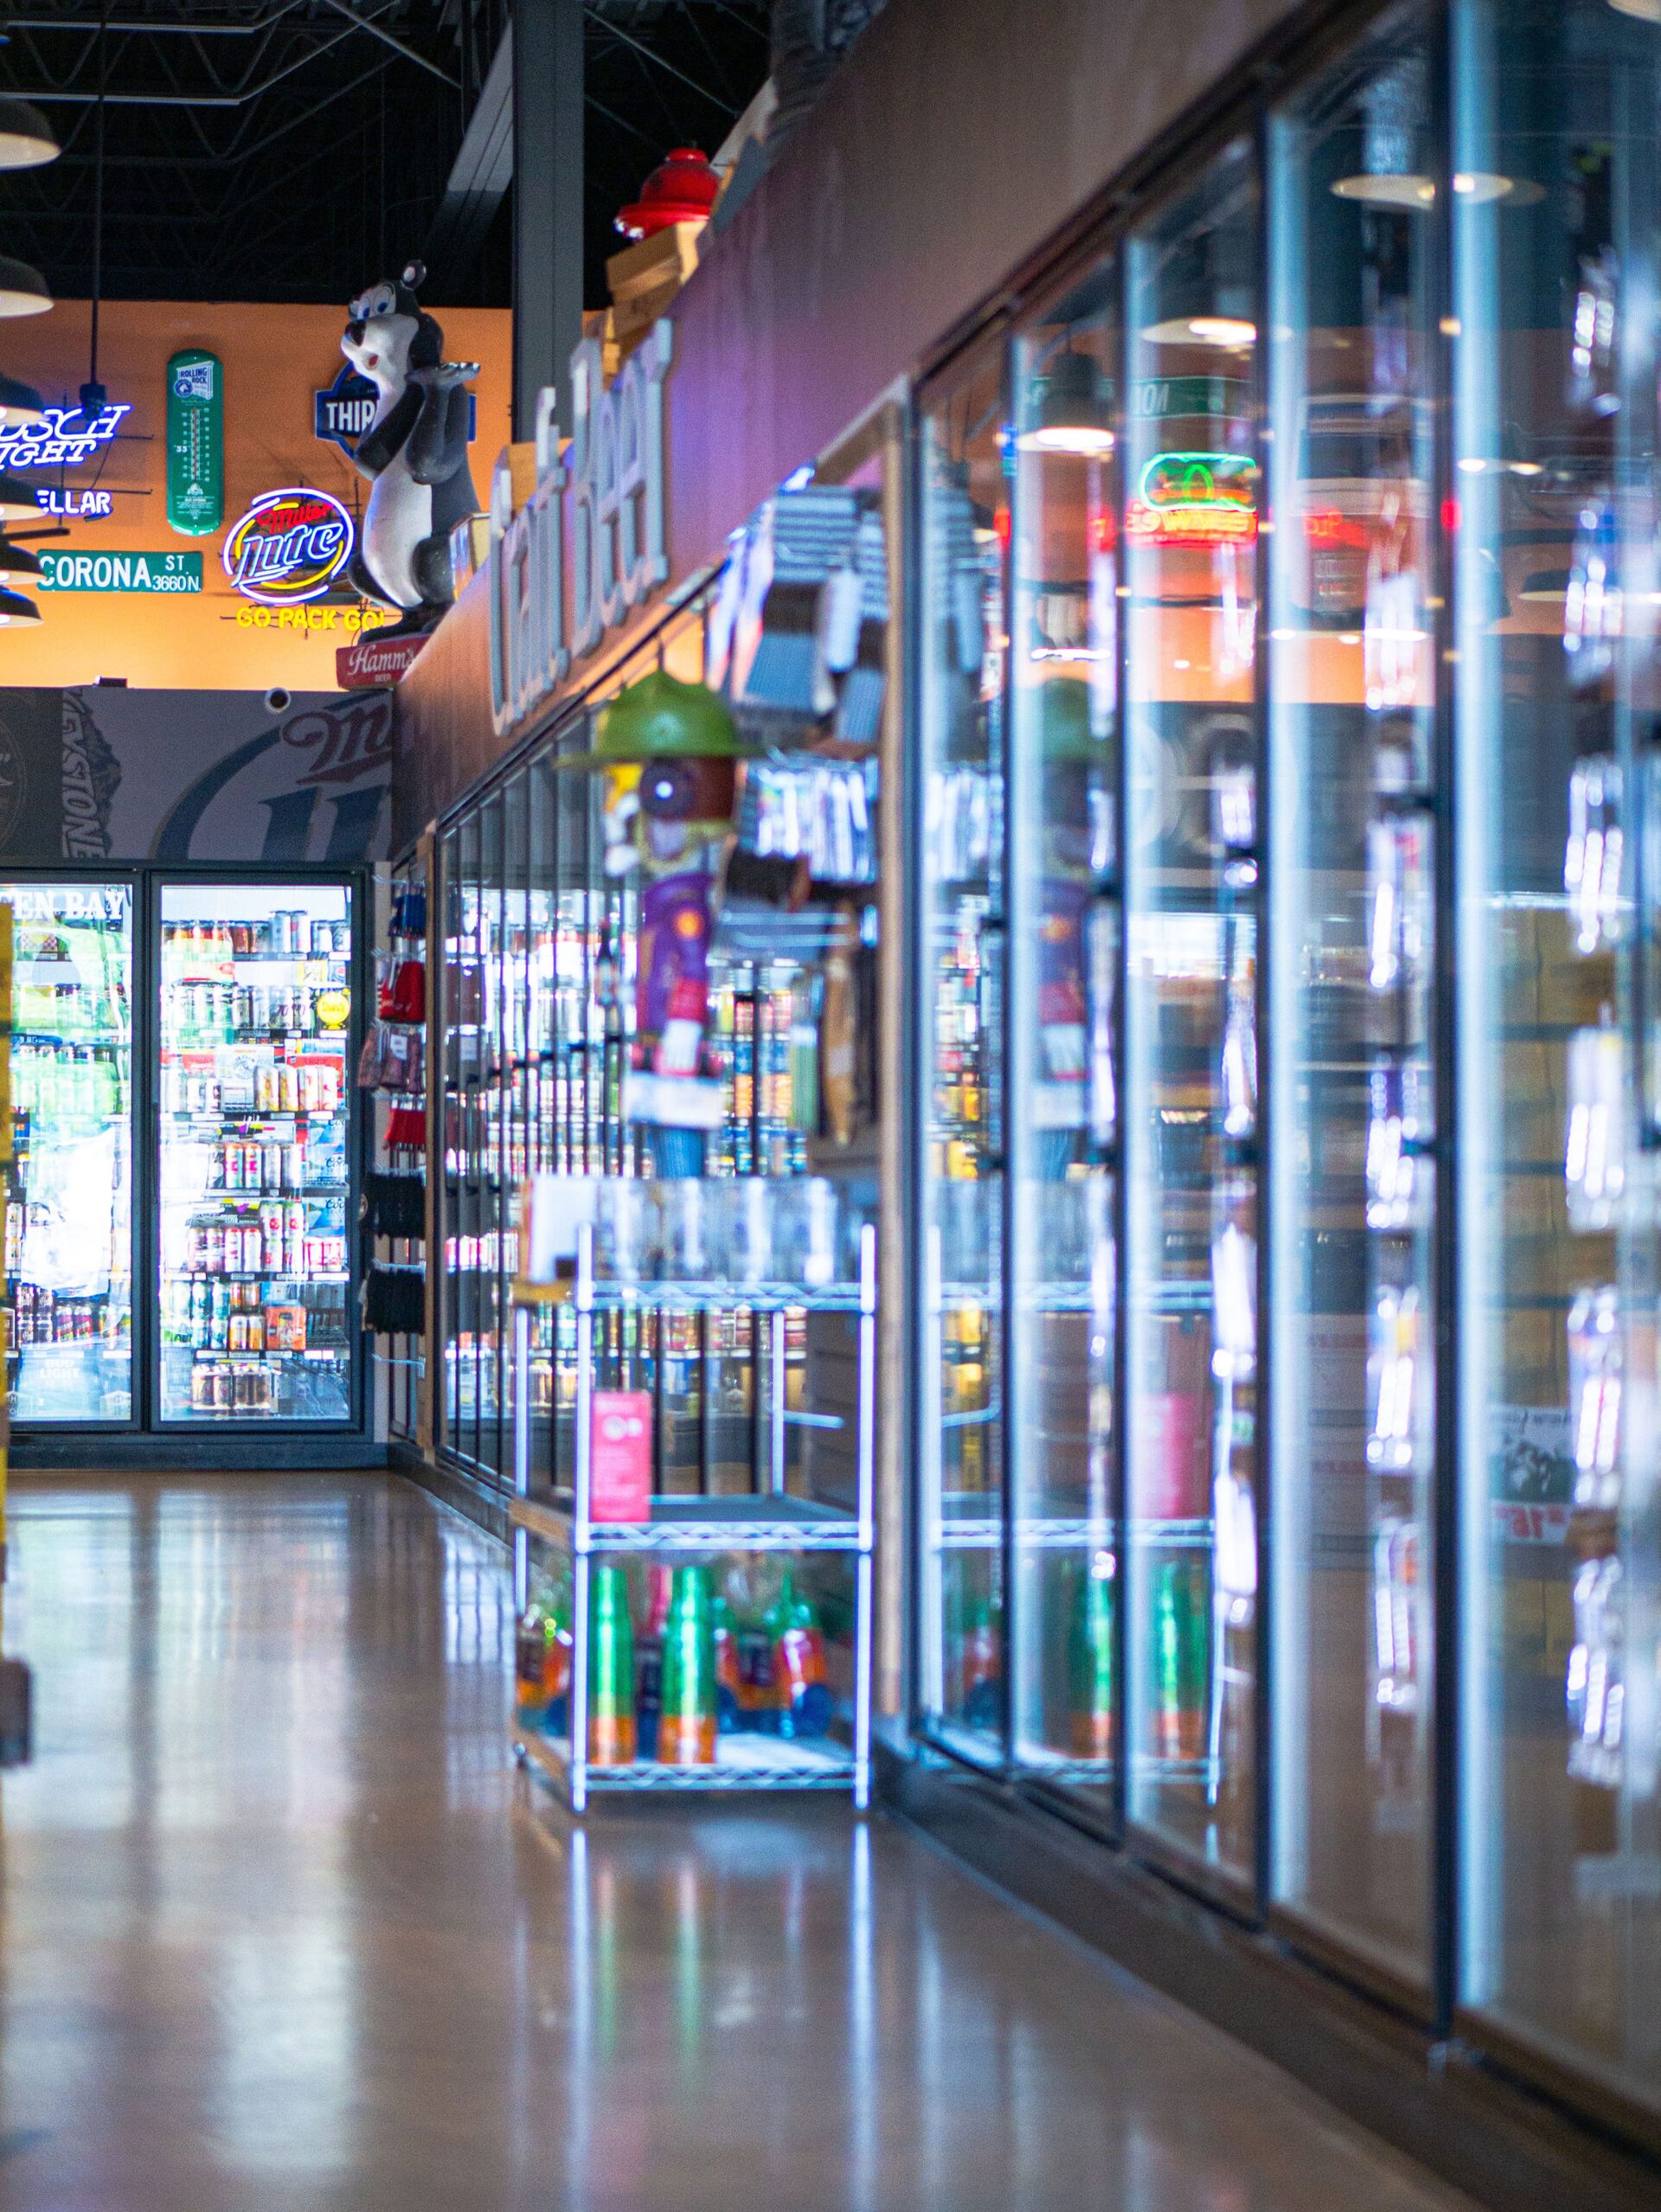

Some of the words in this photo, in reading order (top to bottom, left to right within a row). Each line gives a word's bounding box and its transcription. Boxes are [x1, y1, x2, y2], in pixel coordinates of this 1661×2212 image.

[180, 367, 208, 378] ROLLING
[0, 405, 131, 442] USCH
[326, 400, 376, 433] THIR
[0, 439, 97, 470] IGHT
[36, 490, 111, 514] ELLAR
[257, 503, 334, 535] Miller
[231, 523, 343, 587] Lite
[39, 555, 152, 588] CORONA
[236, 606, 272, 628] GO
[278, 608, 338, 631] PACK
[374, 672, 392, 683] BEER
[61, 689, 106, 858] EYSTONE
[63, 889, 125, 920] BAY
[39, 1368, 80, 1378] LIGHT
